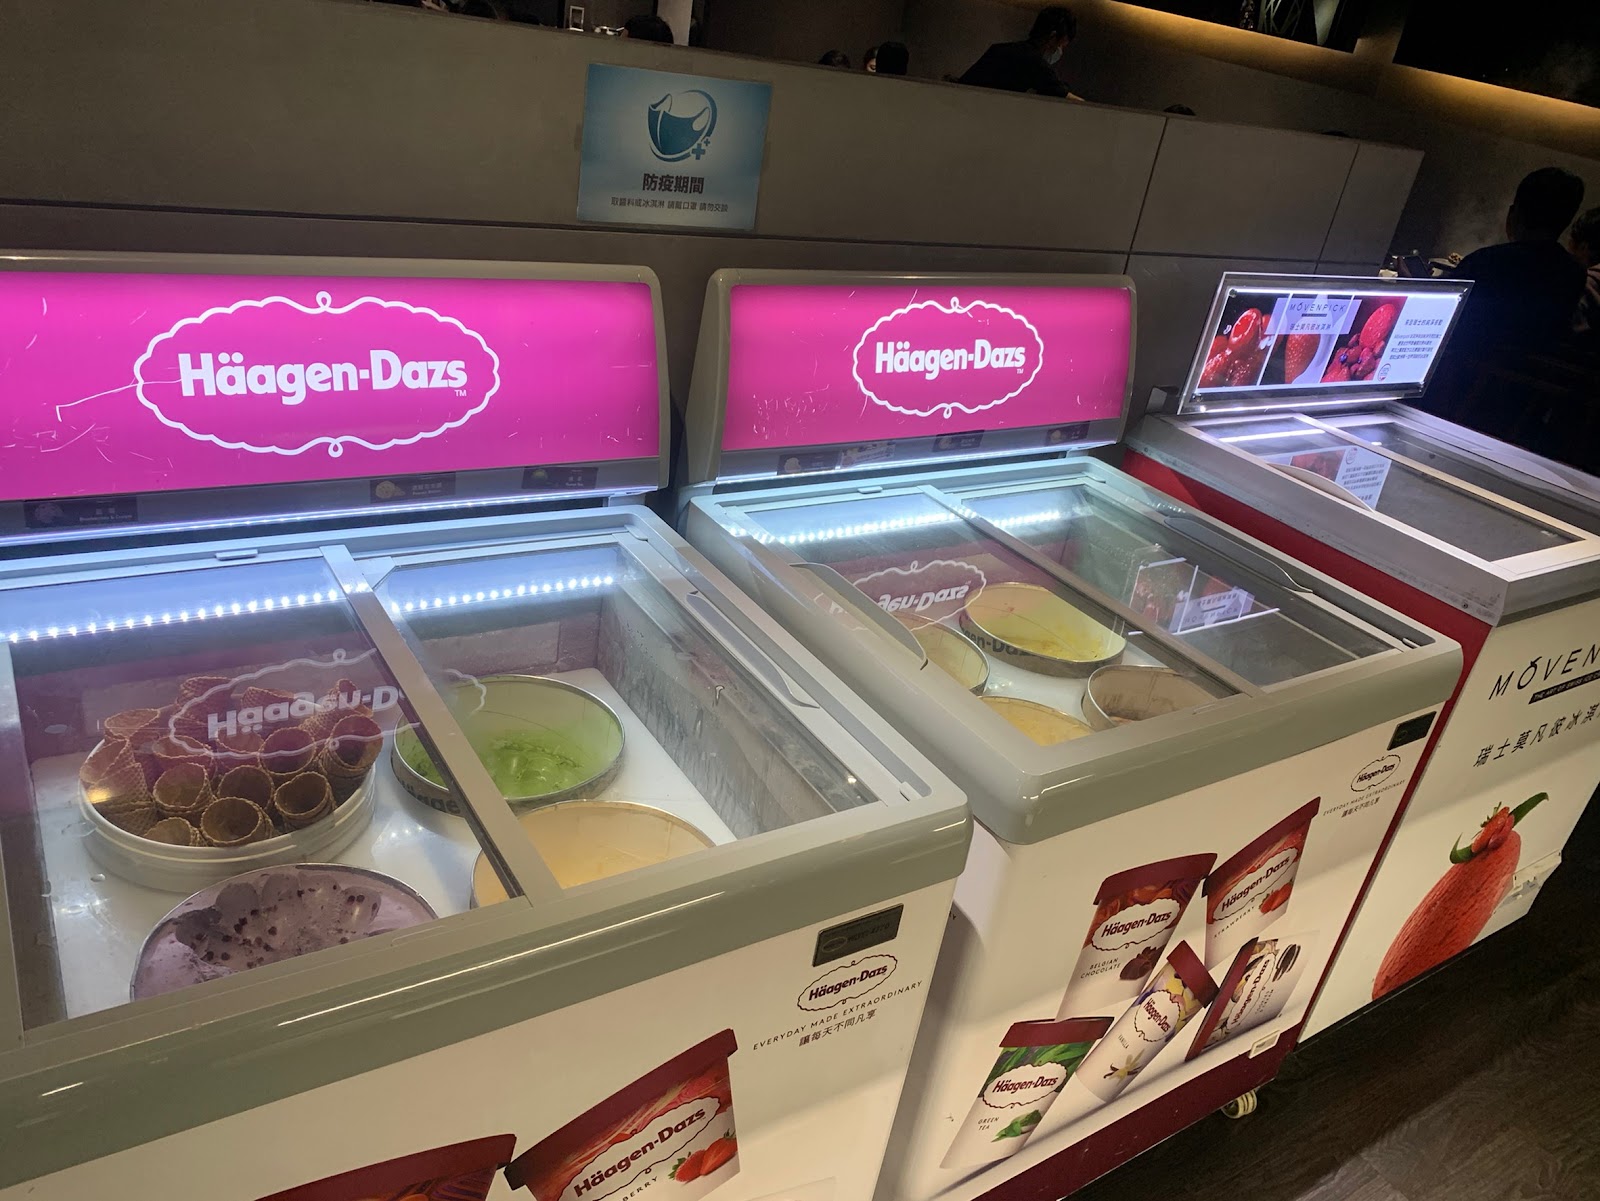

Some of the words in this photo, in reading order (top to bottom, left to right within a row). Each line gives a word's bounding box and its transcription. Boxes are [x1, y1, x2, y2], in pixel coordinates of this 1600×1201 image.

[642, 173, 704, 194] 防疫期間
[699, 202, 728, 213] 請勿交談
[178, 349, 468, 405] Häagen-Dazs
[875, 339, 1026, 380] Häagen-Dazs
[1473, 703, 1600, 767] 瑞士莫凡彼冰淇
[1221, 856, 1290, 912] Häagen-Dazs
[1101, 912, 1172, 937] Häagen-Dazs
[1080, 963, 1121, 979] CHOCOLATE
[1090, 958, 1119, 969] BELGIAN
[808, 965, 887, 1001] Häagen-Dazs
[753, 1025, 807, 1050] EVERYDAY
[811, 1013, 838, 1028] MADE
[843, 980, 922, 1016] EXTRAORDINARY
[1142, 997, 1171, 1033] Häagen-Dazs
[992, 1076, 1059, 1094] Häagen-Dazs
[978, 1117, 1000, 1125] GREEN
[573, 1108, 706, 1198] Häagen-Dazs
